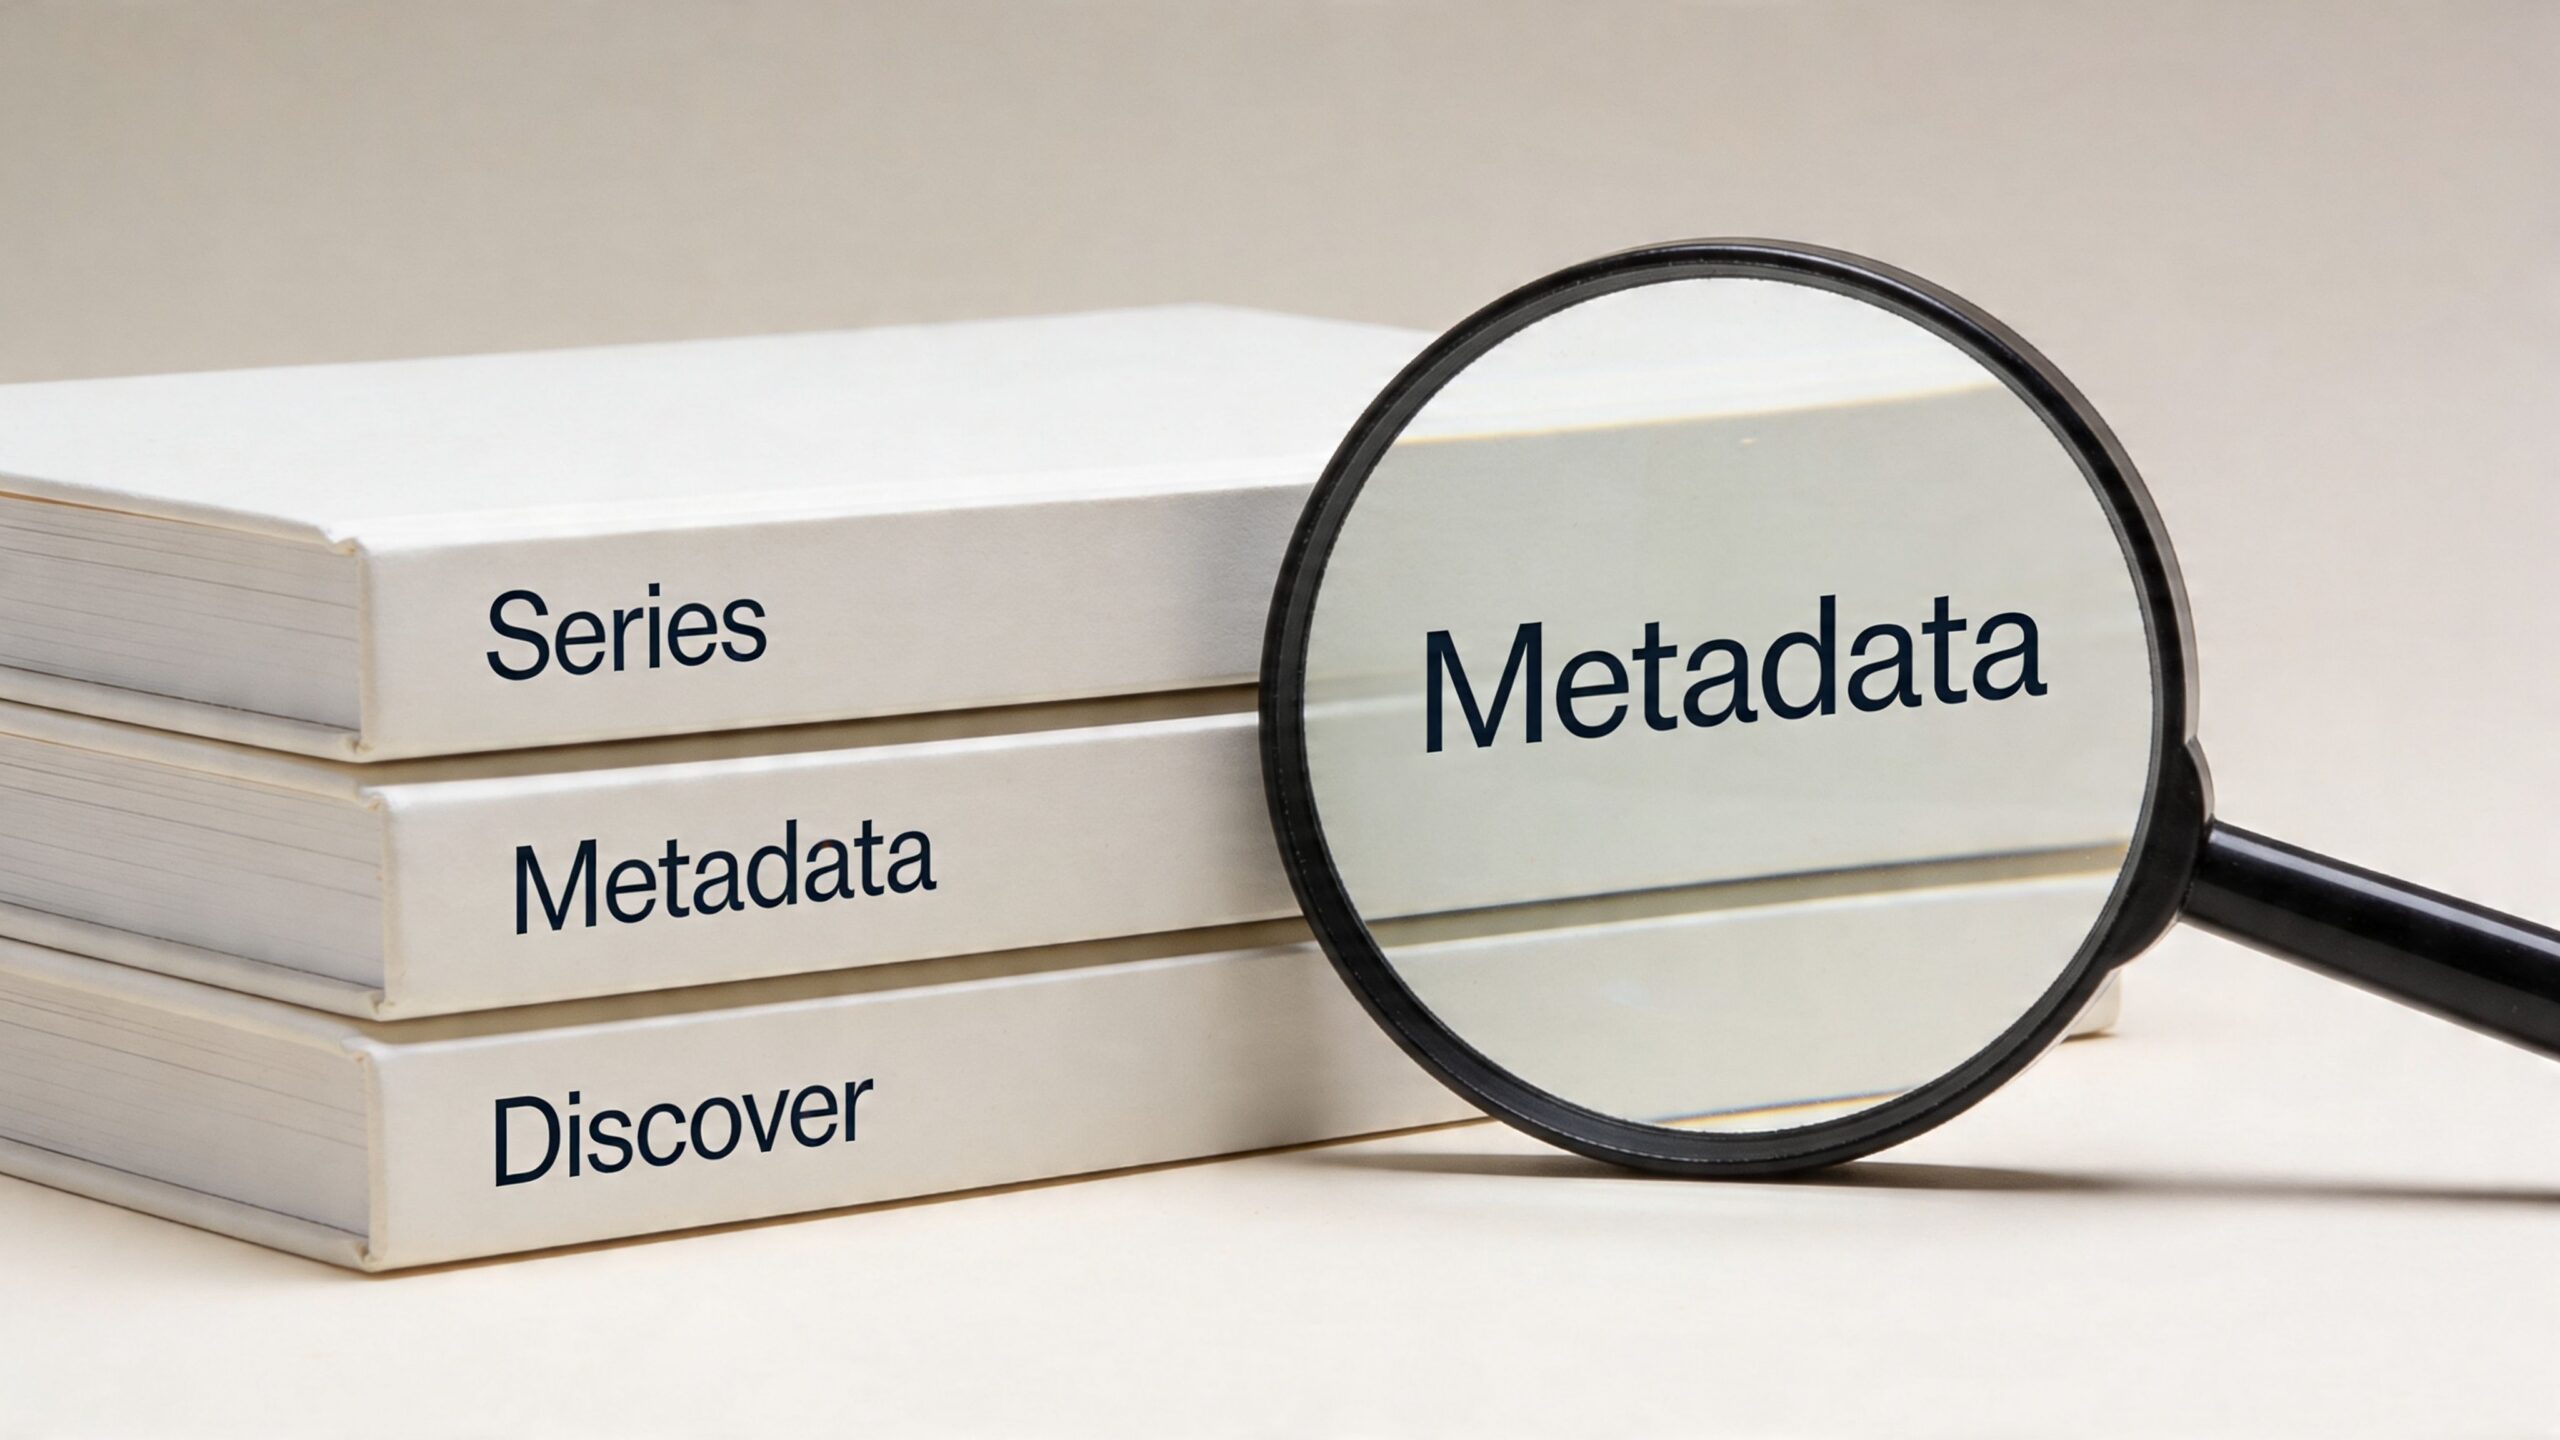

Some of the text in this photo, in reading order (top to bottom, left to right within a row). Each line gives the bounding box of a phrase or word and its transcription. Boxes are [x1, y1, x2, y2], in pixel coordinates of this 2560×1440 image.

[487, 583, 766, 680] Series
[1427, 595, 2047, 753] Metadata
[516, 819, 937, 935] Metadata
[496, 1079, 873, 1186] Discover
